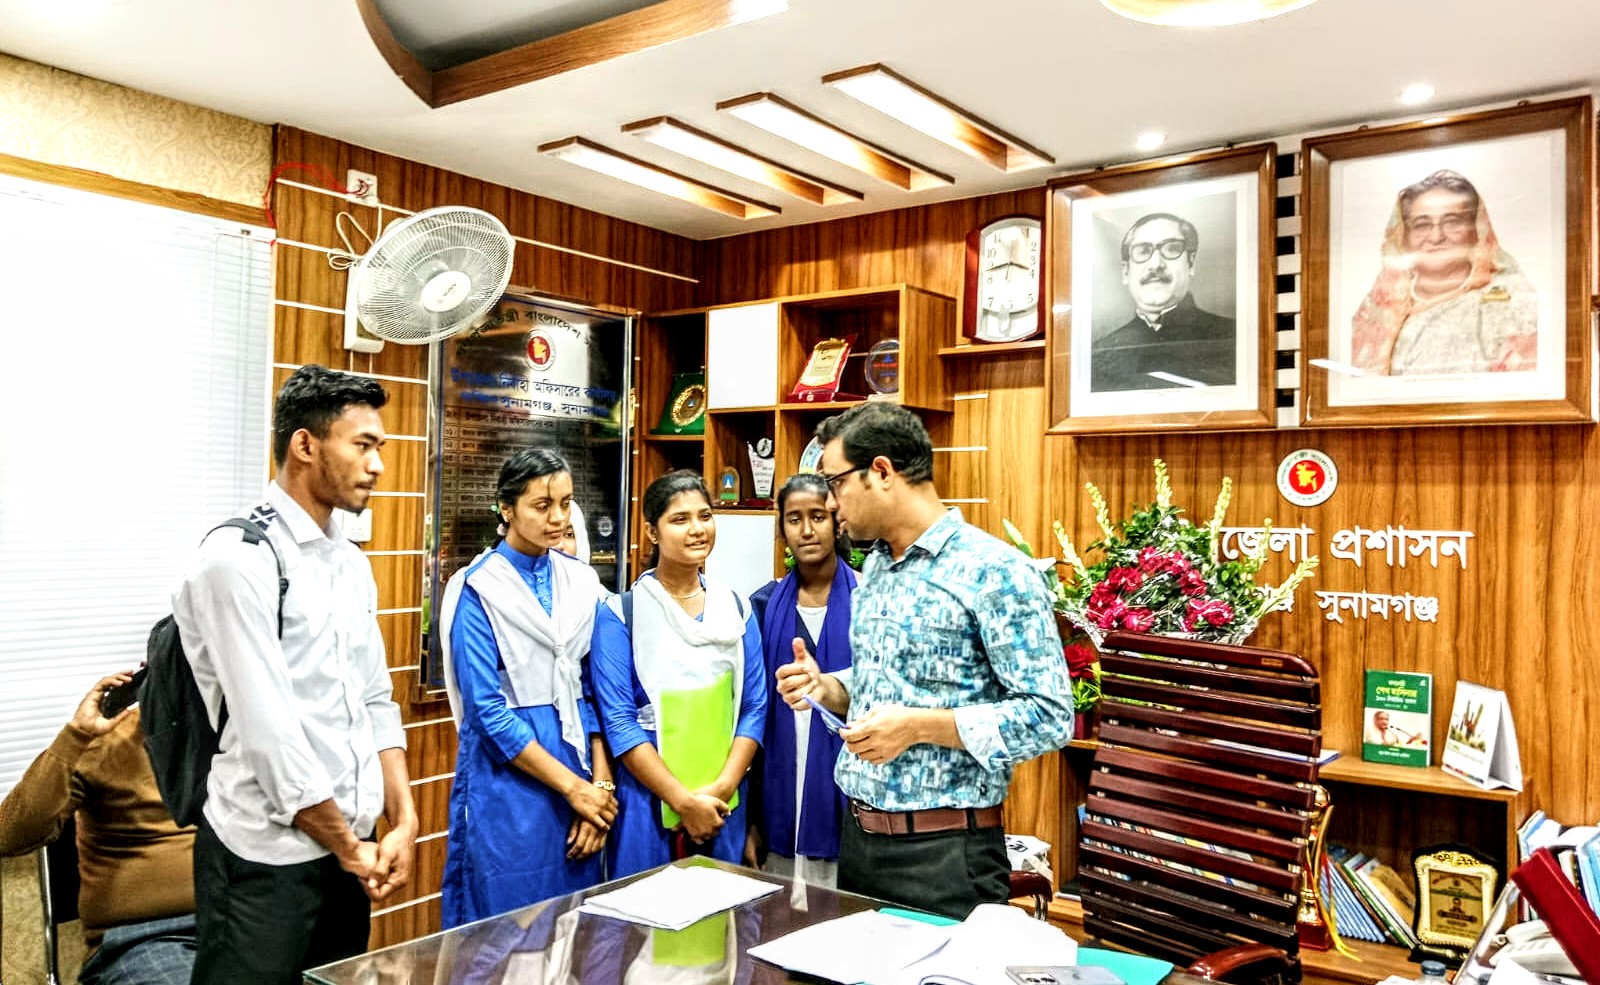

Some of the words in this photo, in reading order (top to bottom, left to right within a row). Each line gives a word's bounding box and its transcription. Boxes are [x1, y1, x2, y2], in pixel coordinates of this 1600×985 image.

[987, 248, 997, 259] 10
[532, 378, 581, 398] অফিসারের
[1219, 523, 1315, 563] জেলা
[1330, 524, 1474, 569] প্রশাসন
[1315, 590, 1439, 623] সুনামগঞ্জ
